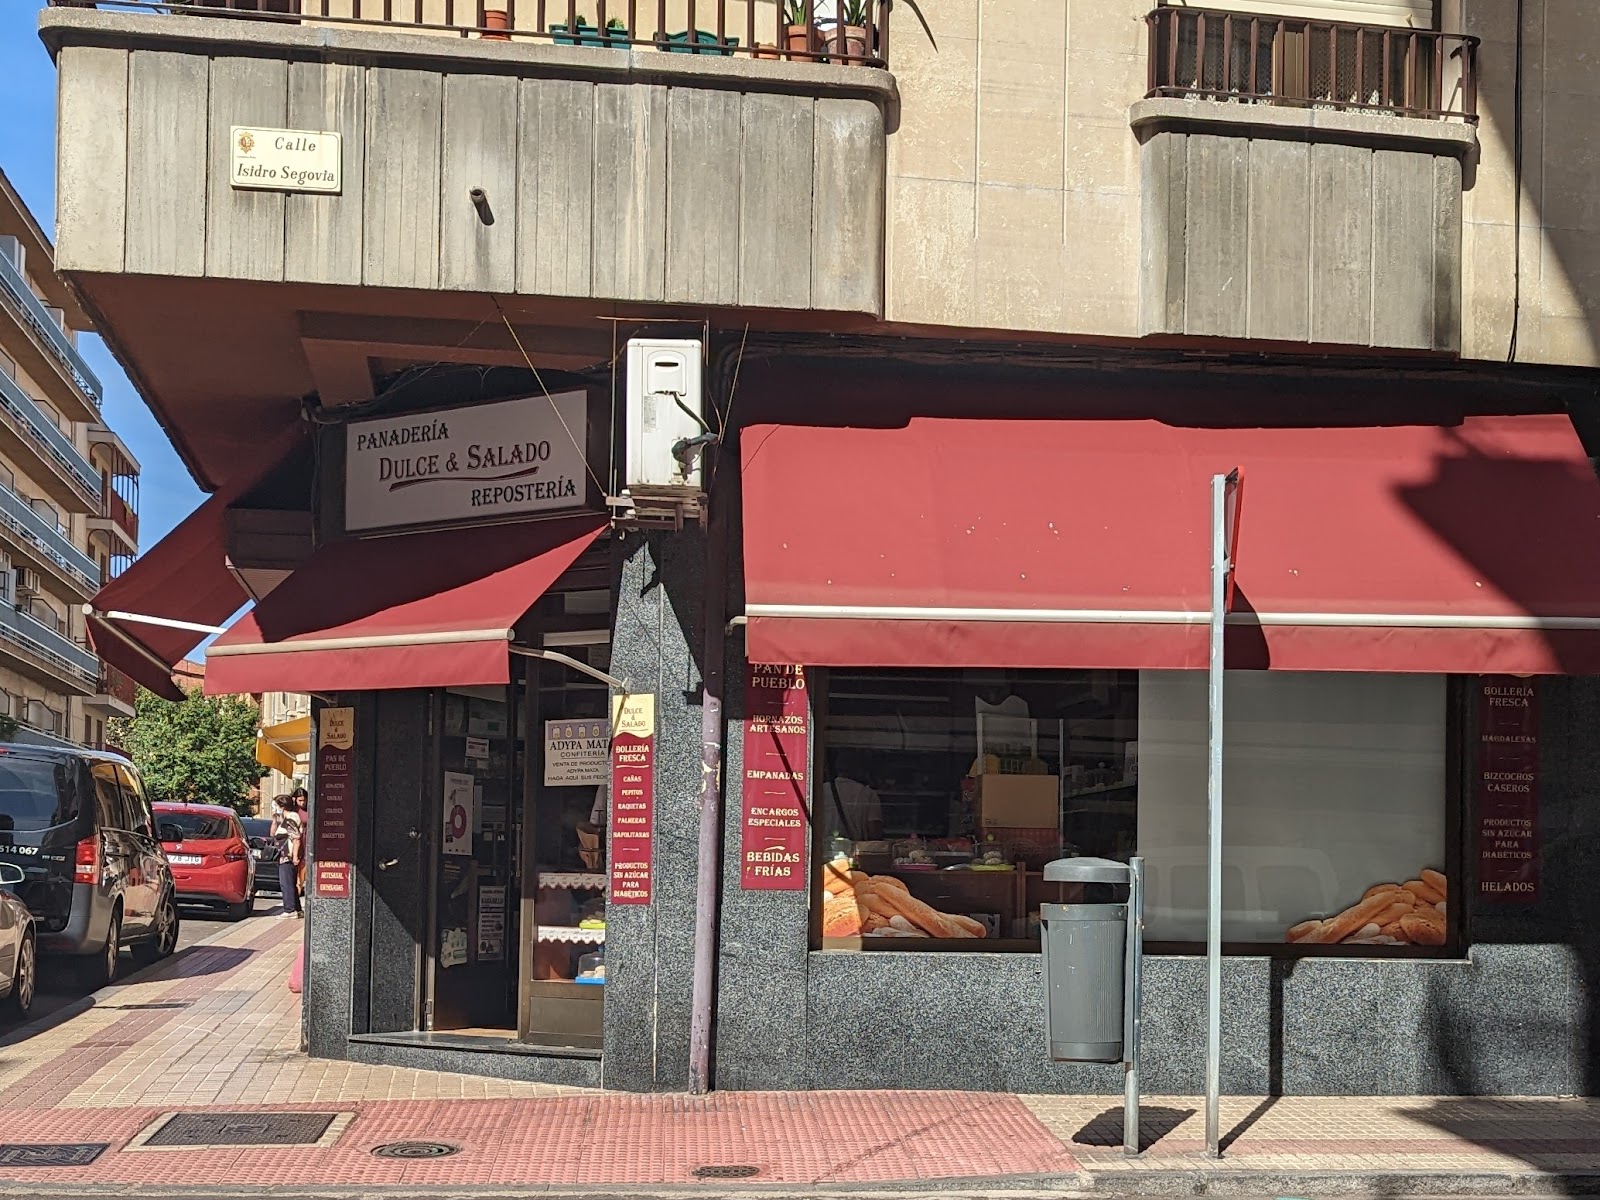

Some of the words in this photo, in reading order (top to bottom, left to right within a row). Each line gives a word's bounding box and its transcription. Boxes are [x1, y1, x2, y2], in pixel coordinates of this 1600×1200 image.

[274, 136, 316, 152] Calle
[236, 163, 277, 179] Isidro
[280, 165, 335, 185] Segovia
[357, 419, 450, 451] PANADERÍA
[379, 454, 439, 482] DULCE
[446, 452, 460, 472] &
[467, 440, 551, 470] SALADO
[471, 475, 577, 507] REPOSTERÍA
[753, 662, 782, 674] PAN
[785, 664, 804, 675] DE
[752, 676, 806, 690] PUEBLO
[1484, 685, 1534, 697] BOLLERÍA
[1489, 697, 1529, 707] FRESCA
[621, 720, 646, 728] SALADO
[752, 715, 804, 724] HORNAZOS
[550, 740, 582, 750] ADYPA
[586, 739, 608, 750] MAT
[616, 743, 650, 754] BOLLERÍA
[560, 750, 606, 758] CONFITERÍA
[618, 754, 646, 762] FRESCA
[747, 770, 804, 780] EMPANADAS
[1484, 772, 1534, 781] BIZCOCHOS
[1487, 784, 1530, 793] CASEROS
[750, 807, 799, 816] ENCARGOS
[748, 818, 802, 828] ESPECIALES
[1484, 818, 1532, 827] PRODUCTOS
[1482, 829, 1496, 837] SIN
[1495, 840, 1519, 848] PARA
[18, 846, 38, 855] 067
[746, 852, 800, 863] BEBIDAS
[614, 862, 648, 870] PRODUCTOS
[754, 864, 791, 877] FRÍAS
[1481, 882, 1535, 892] HELADOS
